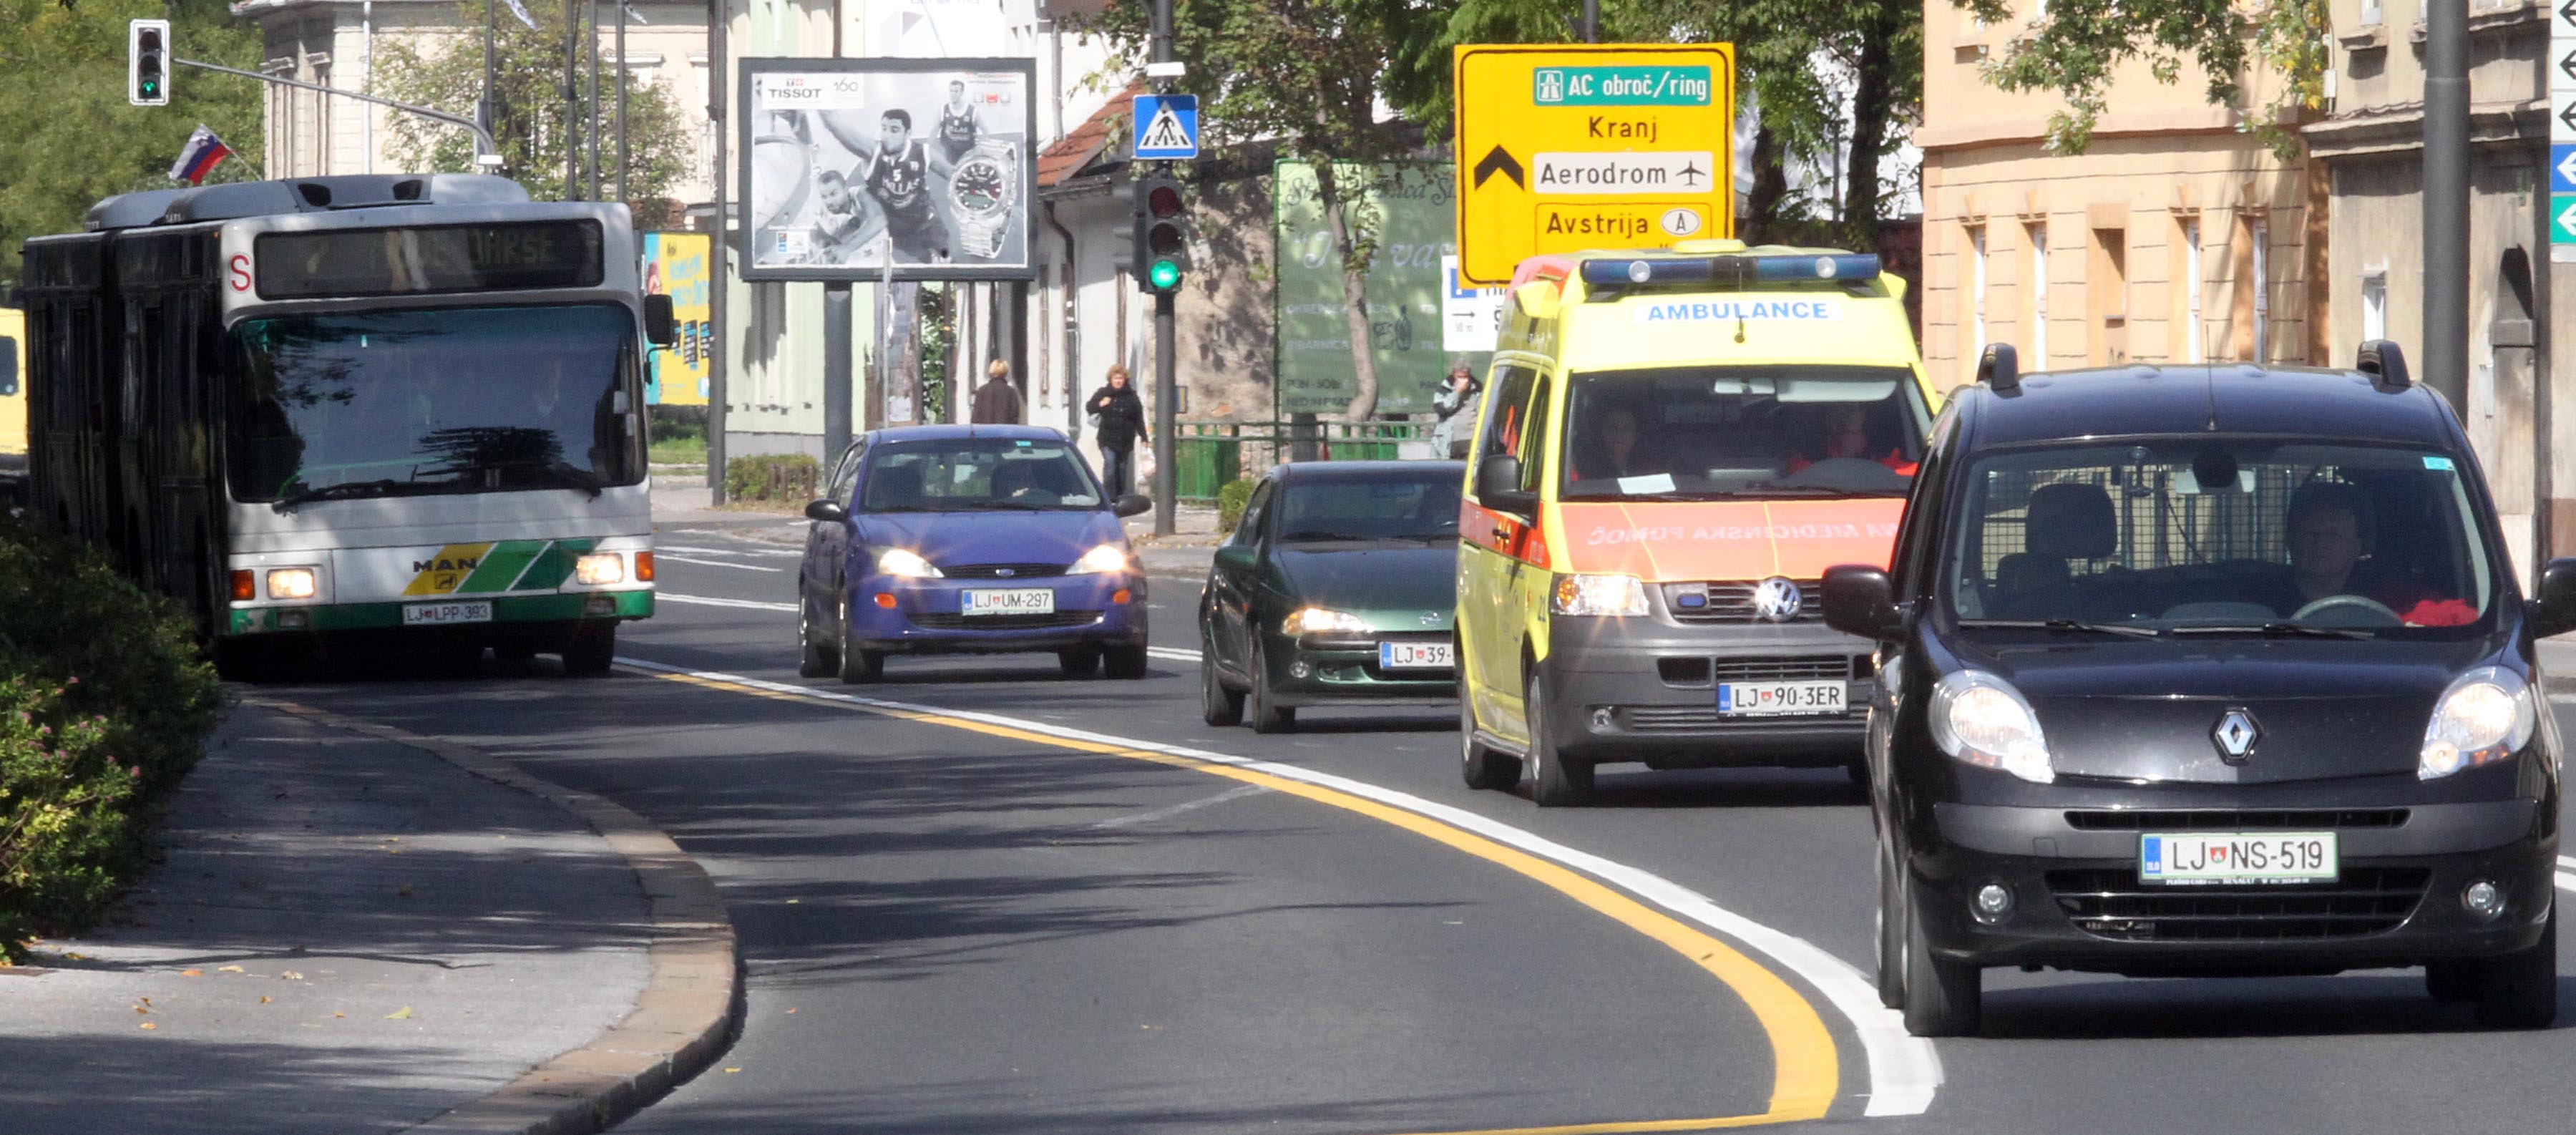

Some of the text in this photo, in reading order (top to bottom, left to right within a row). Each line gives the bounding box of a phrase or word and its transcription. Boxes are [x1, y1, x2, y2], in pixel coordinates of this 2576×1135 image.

[768, 88, 821, 98] TISSOT
[833, 77, 859, 92] 160
[1568, 71, 1707, 102] AC obroč/ring
[1589, 115, 1658, 144] Kranj
[893, 168, 902, 182] 5
[1540, 162, 1667, 185] Aerodrom
[1546, 211, 1687, 239] Avstrija A
[230, 254, 252, 291] S
[1647, 302, 1829, 321] AMBULANCE
[413, 557, 477, 573] MAN
[975, 593, 1050, 608] LJ UM-297
[406, 605, 488, 622] LJ LPP-393
[1395, 646, 1414, 663] LJ
[1735, 686, 1840, 708] LJ 90-3ER
[2172, 841, 2323, 870] LJ NS-519
